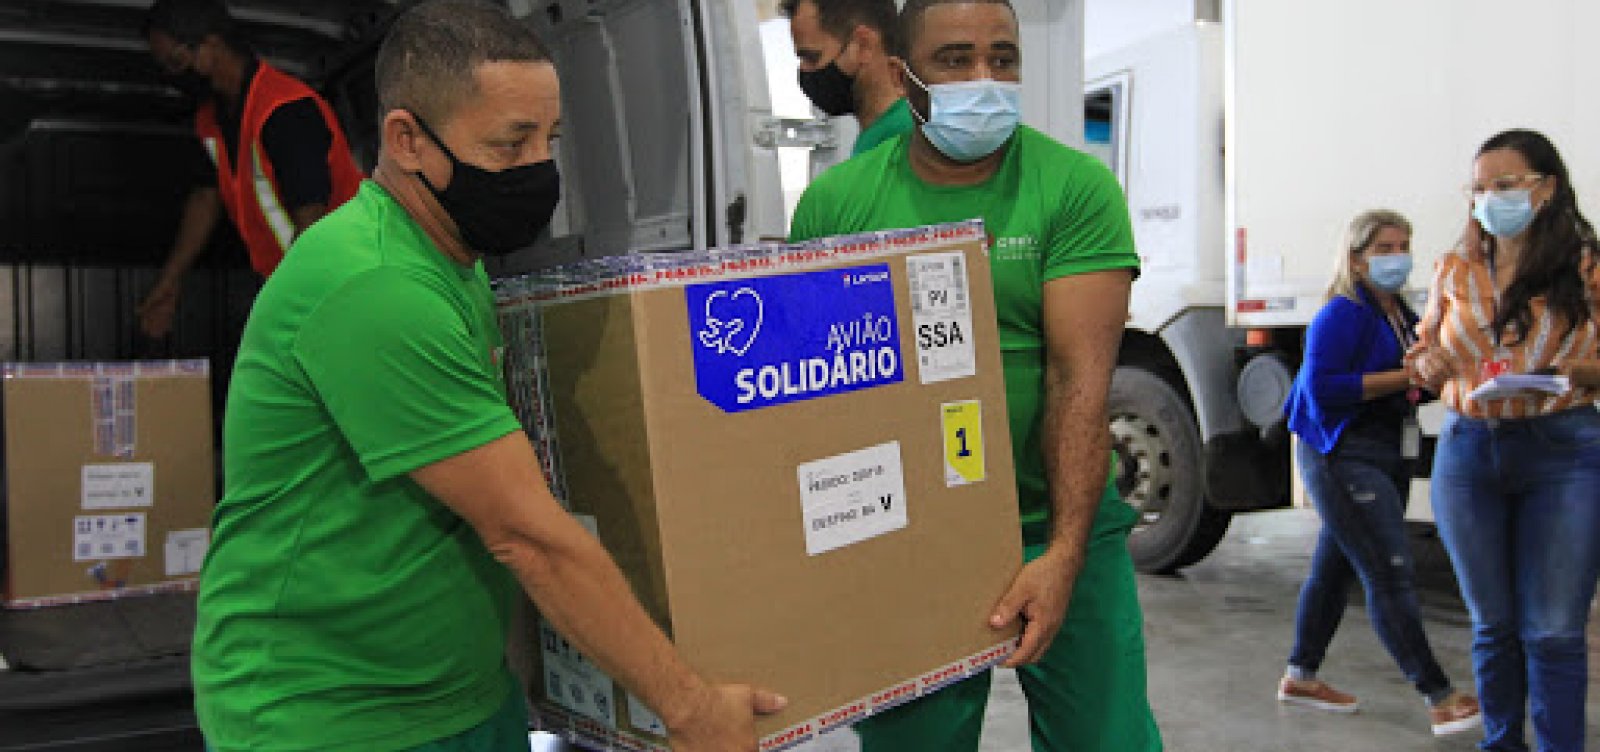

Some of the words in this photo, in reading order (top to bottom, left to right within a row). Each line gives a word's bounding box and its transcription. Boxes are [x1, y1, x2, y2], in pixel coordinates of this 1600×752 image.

[825, 312, 892, 350] AVIÃO
[919, 321, 964, 350] SSA
[735, 345, 898, 403] SOLIDÁRIO
[956, 428, 972, 456] 1
[879, 494, 893, 512] V
